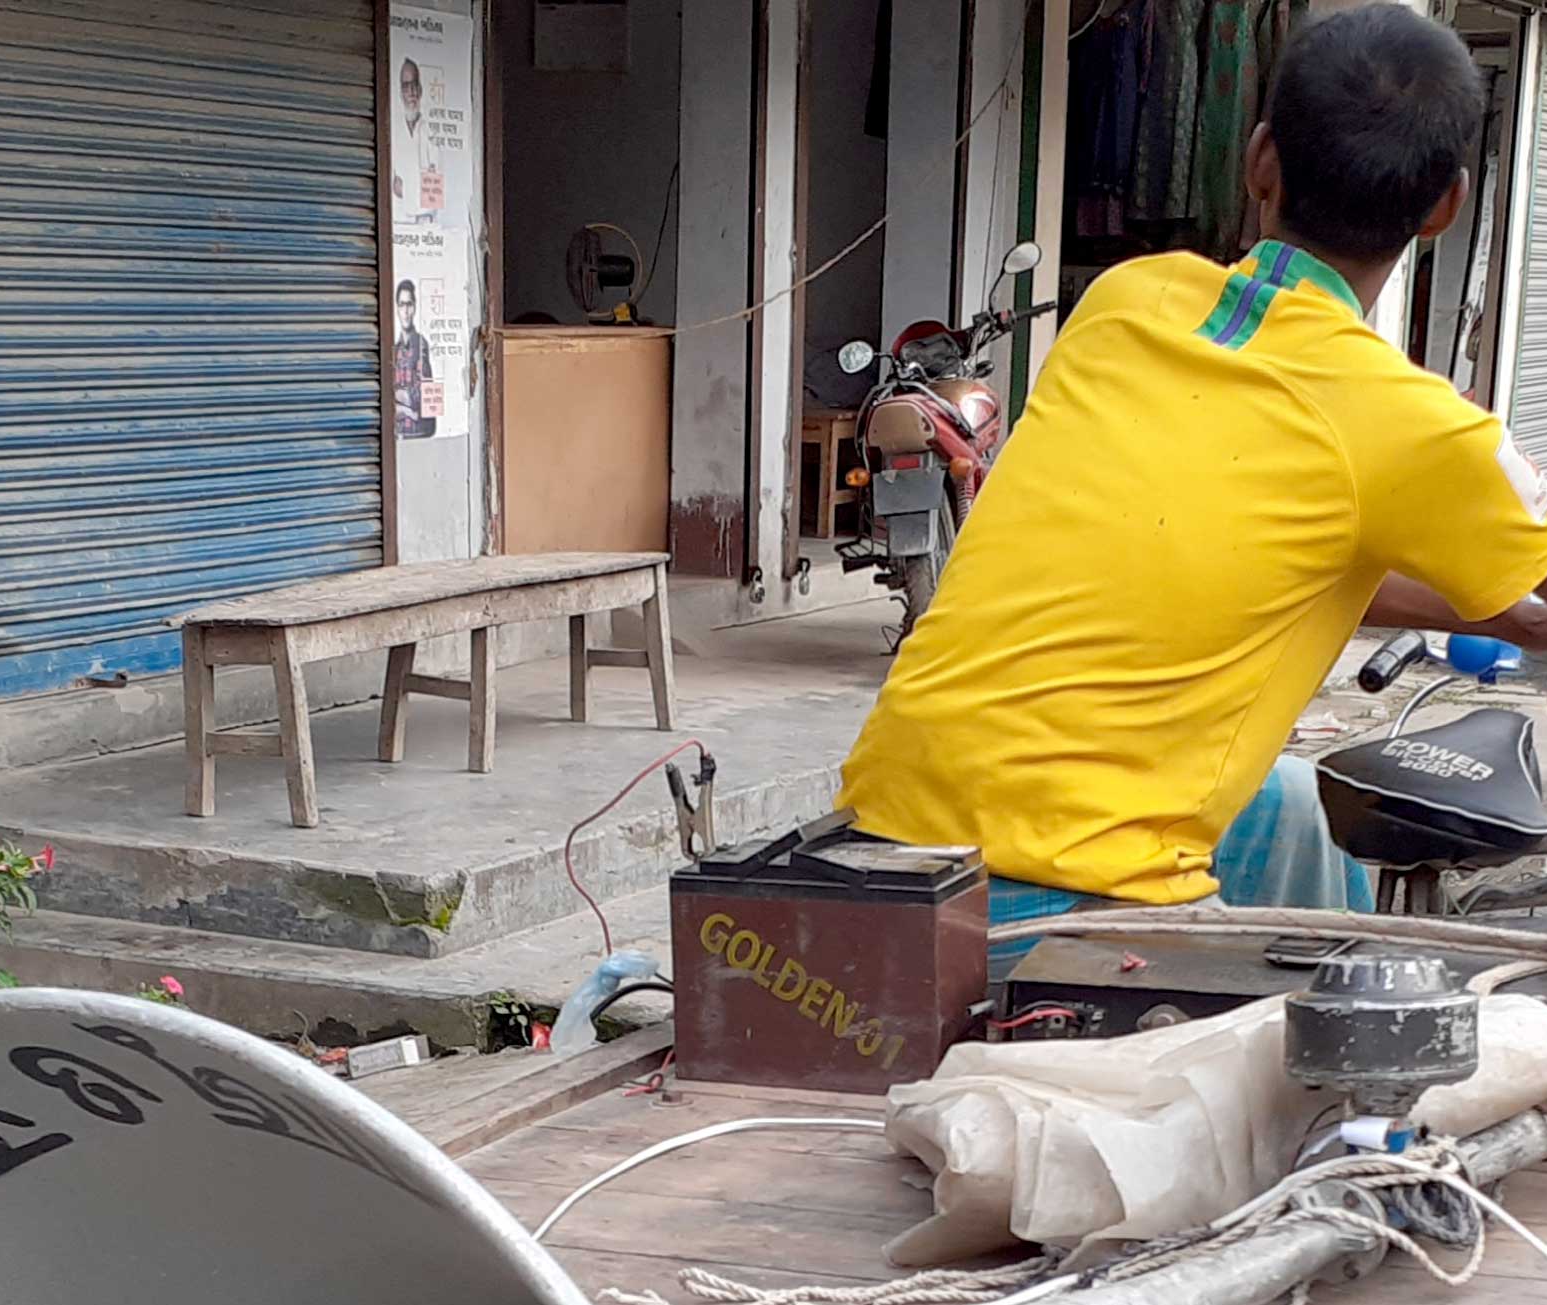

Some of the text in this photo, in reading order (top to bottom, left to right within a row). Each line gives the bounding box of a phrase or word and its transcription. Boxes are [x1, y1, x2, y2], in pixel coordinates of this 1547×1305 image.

[1386, 739, 1494, 779] POWER
[1398, 759, 1453, 778] 2020
[700, 912, 859, 1038] GOLDEN
